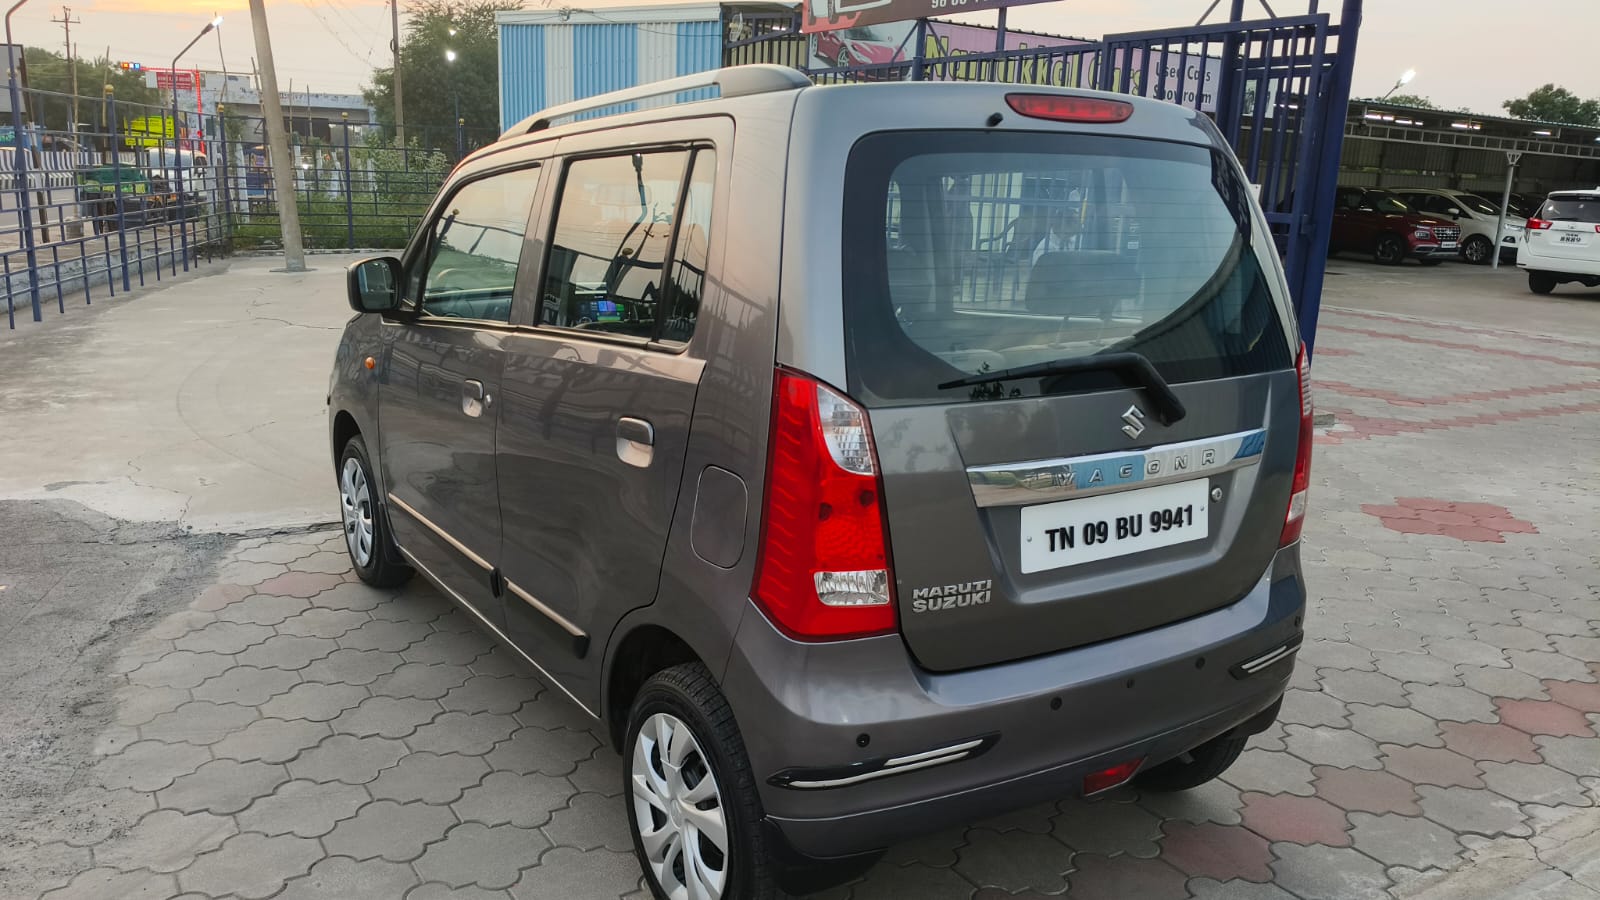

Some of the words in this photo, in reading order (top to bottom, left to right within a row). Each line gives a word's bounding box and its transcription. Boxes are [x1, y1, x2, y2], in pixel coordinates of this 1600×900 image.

[1187, 65, 1211, 82] Cas
[1045, 525, 1075, 552] TN
[1083, 520, 1108, 545] 09
[1116, 514, 1143, 540] BU
[1150, 504, 1193, 533] 9941
[913, 579, 992, 599] MARUTI
[912, 590, 992, 613] SUZUKI
